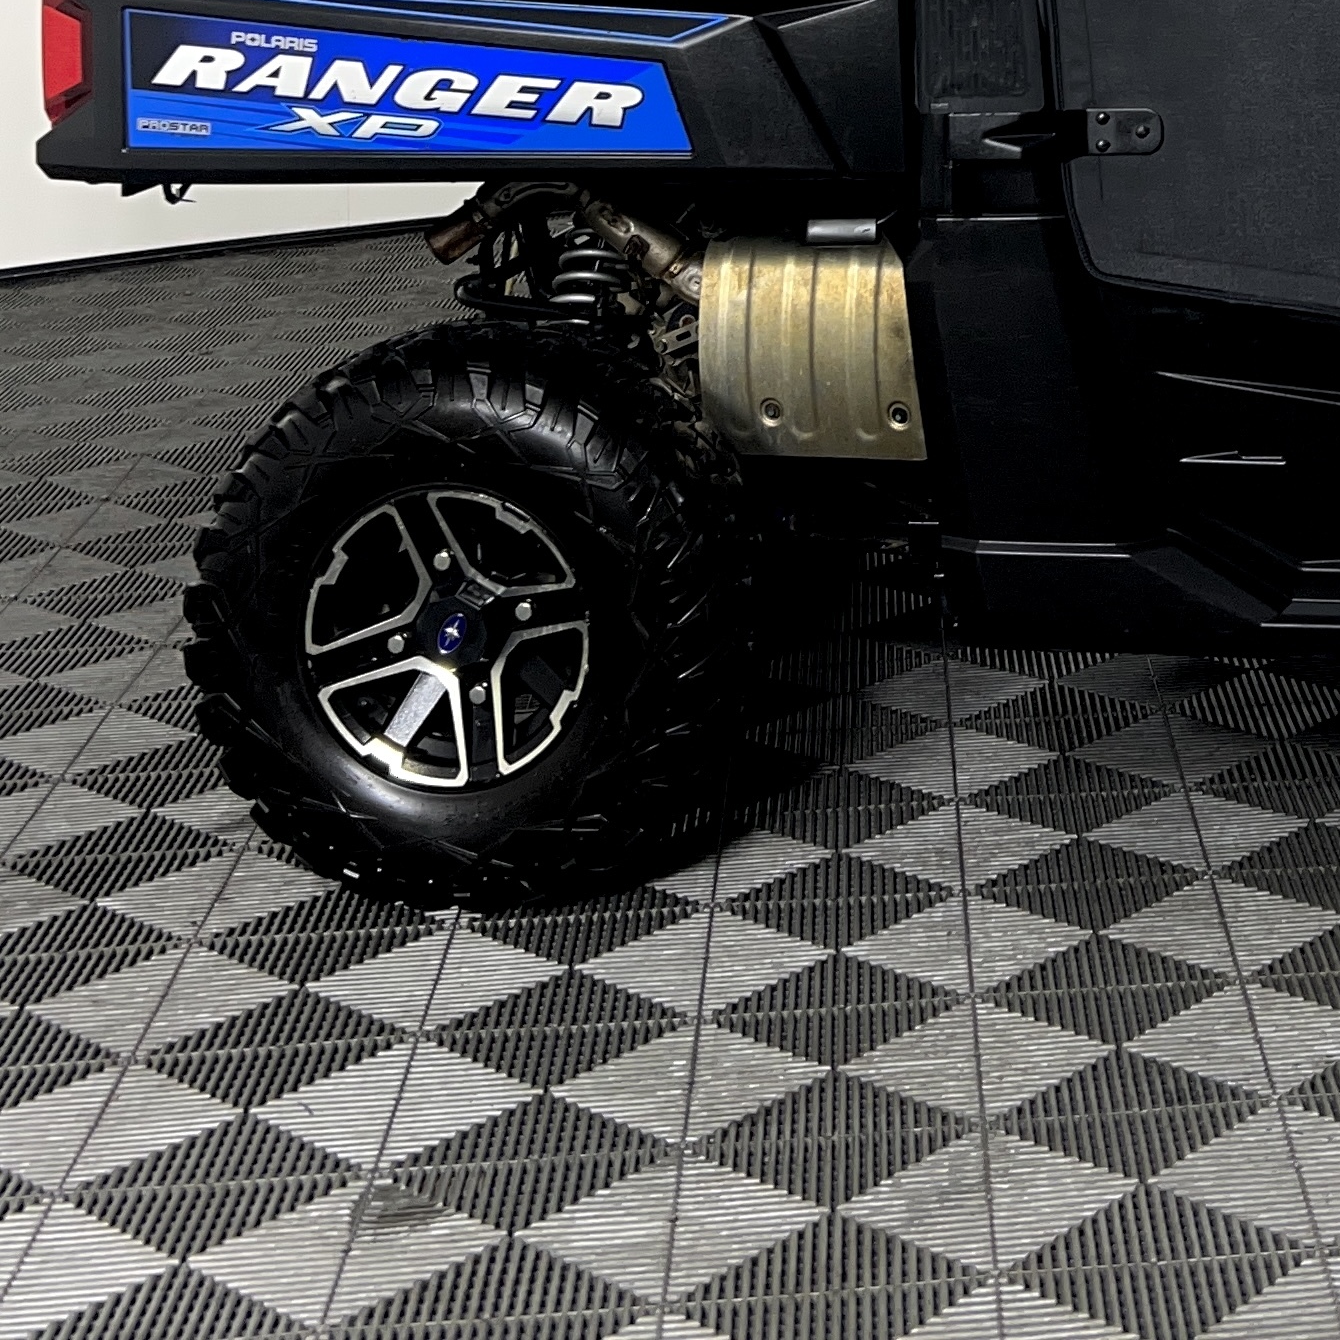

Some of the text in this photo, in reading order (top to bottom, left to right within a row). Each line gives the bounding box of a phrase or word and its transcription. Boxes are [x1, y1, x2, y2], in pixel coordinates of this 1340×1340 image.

[231, 31, 318, 52] POLARIS
[151, 45, 643, 128] RANGER
[138, 119, 210, 134] PROSTAR
[262, 107, 442, 140] XP
